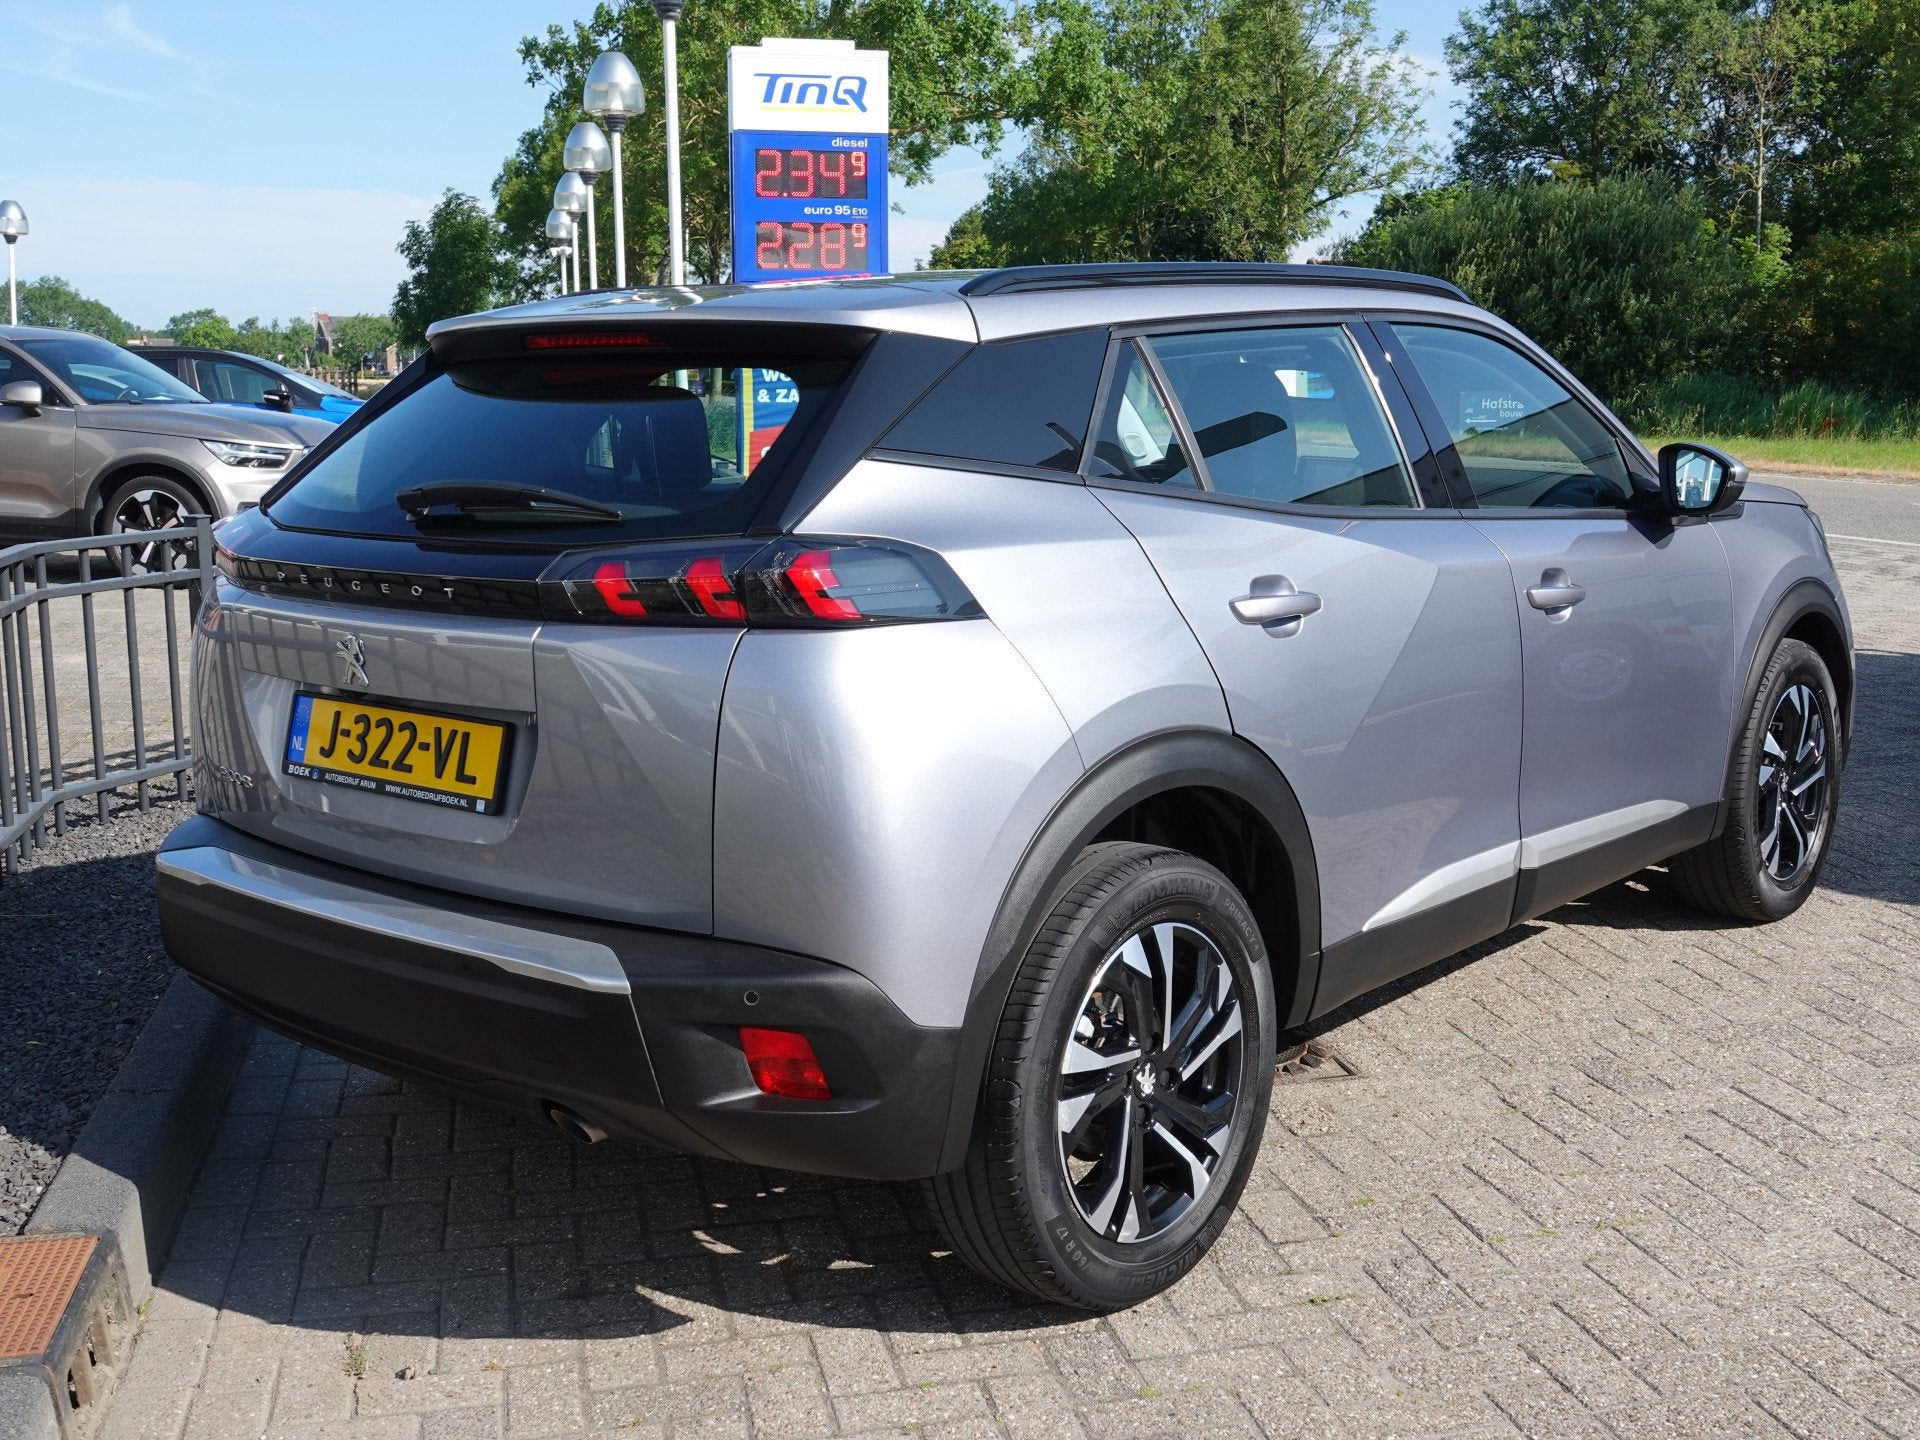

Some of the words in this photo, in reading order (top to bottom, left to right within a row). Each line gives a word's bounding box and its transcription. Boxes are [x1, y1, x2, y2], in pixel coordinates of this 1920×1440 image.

[831, 137, 868, 148] diesel
[804, 206, 833, 215] euro
[834, 205, 851, 215] 95
[852, 207, 868, 215] E10
[757, 388, 771, 403] &
[1481, 398, 1524, 409] Hofstra
[1500, 409, 1523, 418] bouw
[276, 571, 455, 599] PEUGEOT
[291, 735, 304, 752] NL
[318, 710, 477, 786] J-322-VL
[287, 764, 311, 777] BOEK
[324, 773, 360, 785] AUTOBEDRIJF
[360, 779, 377, 789] ARUM
[385, 784, 469, 807] WWW.AUTOBEDRIJFBOEK.NL
[1223, 898, 1257, 944] PRIMACY
[1056, 1226, 1070, 1241] 17
[1065, 1240, 1076, 1252] R
